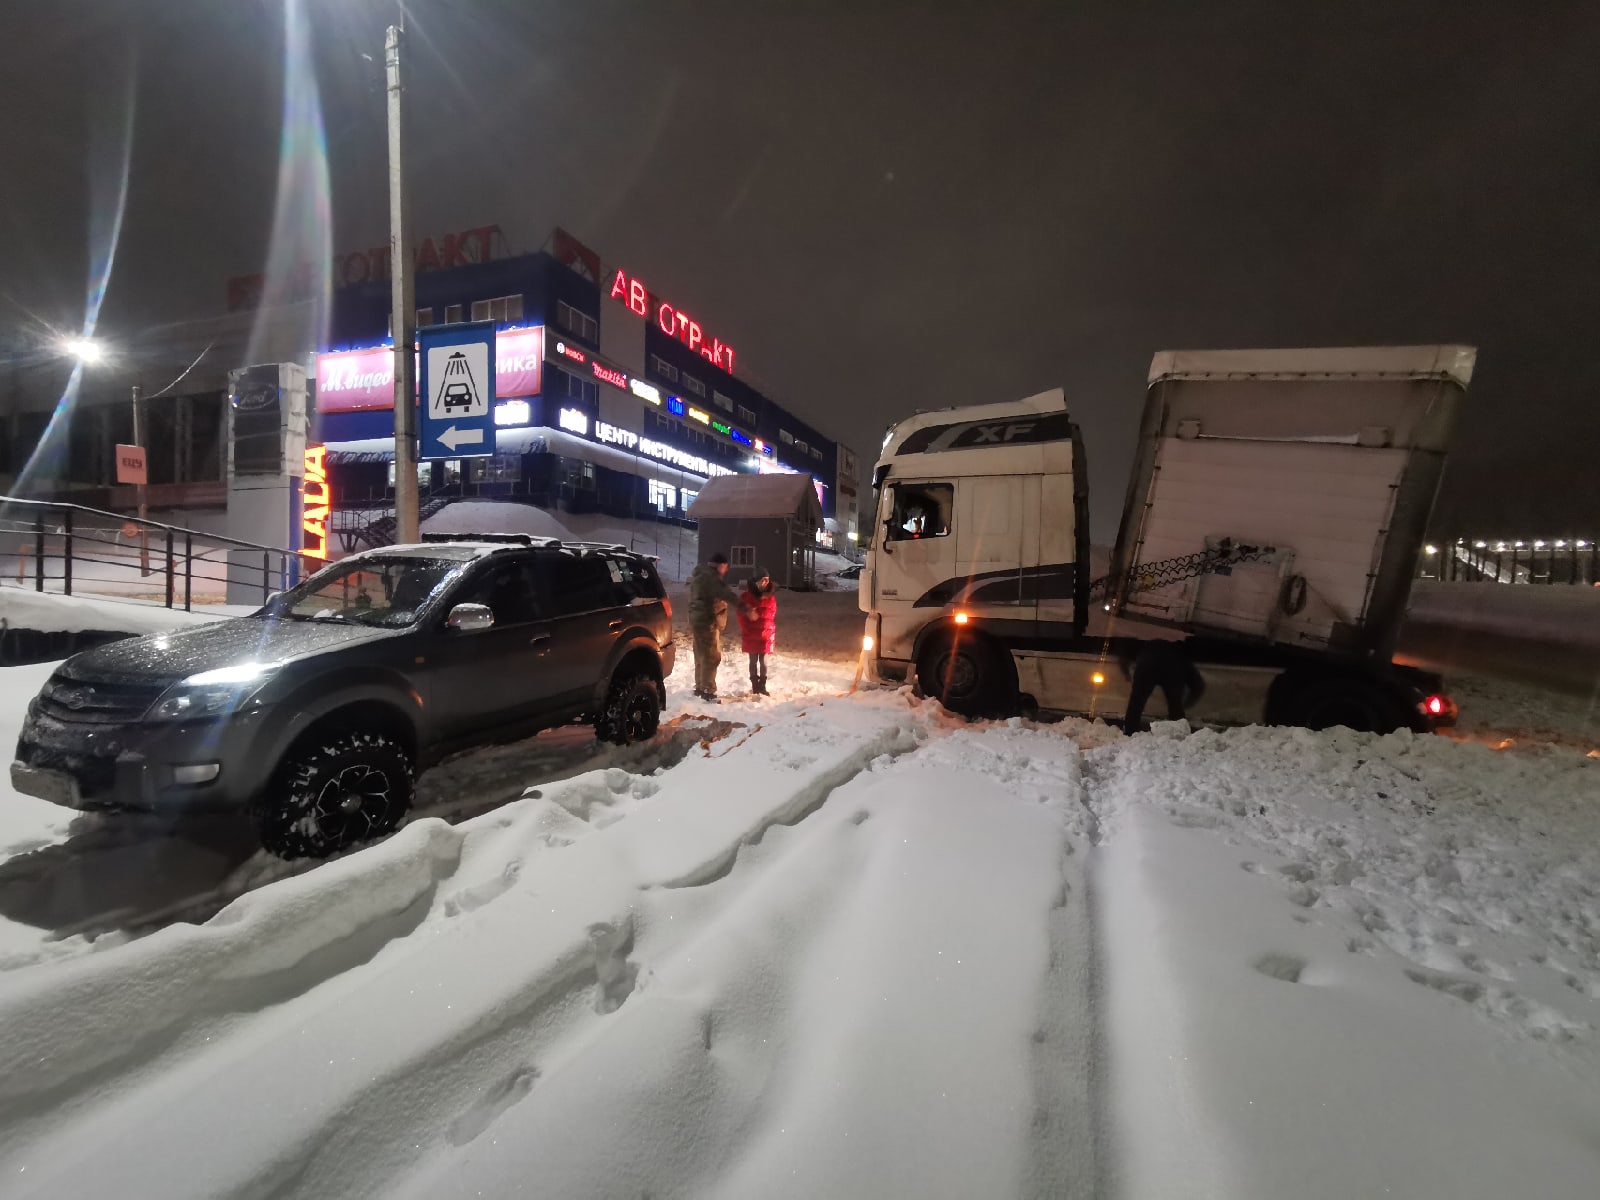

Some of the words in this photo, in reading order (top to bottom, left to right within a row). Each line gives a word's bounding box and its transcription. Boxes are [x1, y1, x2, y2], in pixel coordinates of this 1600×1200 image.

[596, 421, 637, 448] ЦЕНТР
[640, 437, 708, 473] ИНСТРУМЕНТА
[974, 424, 1036, 442] XF
[301, 446, 329, 560] LADA
